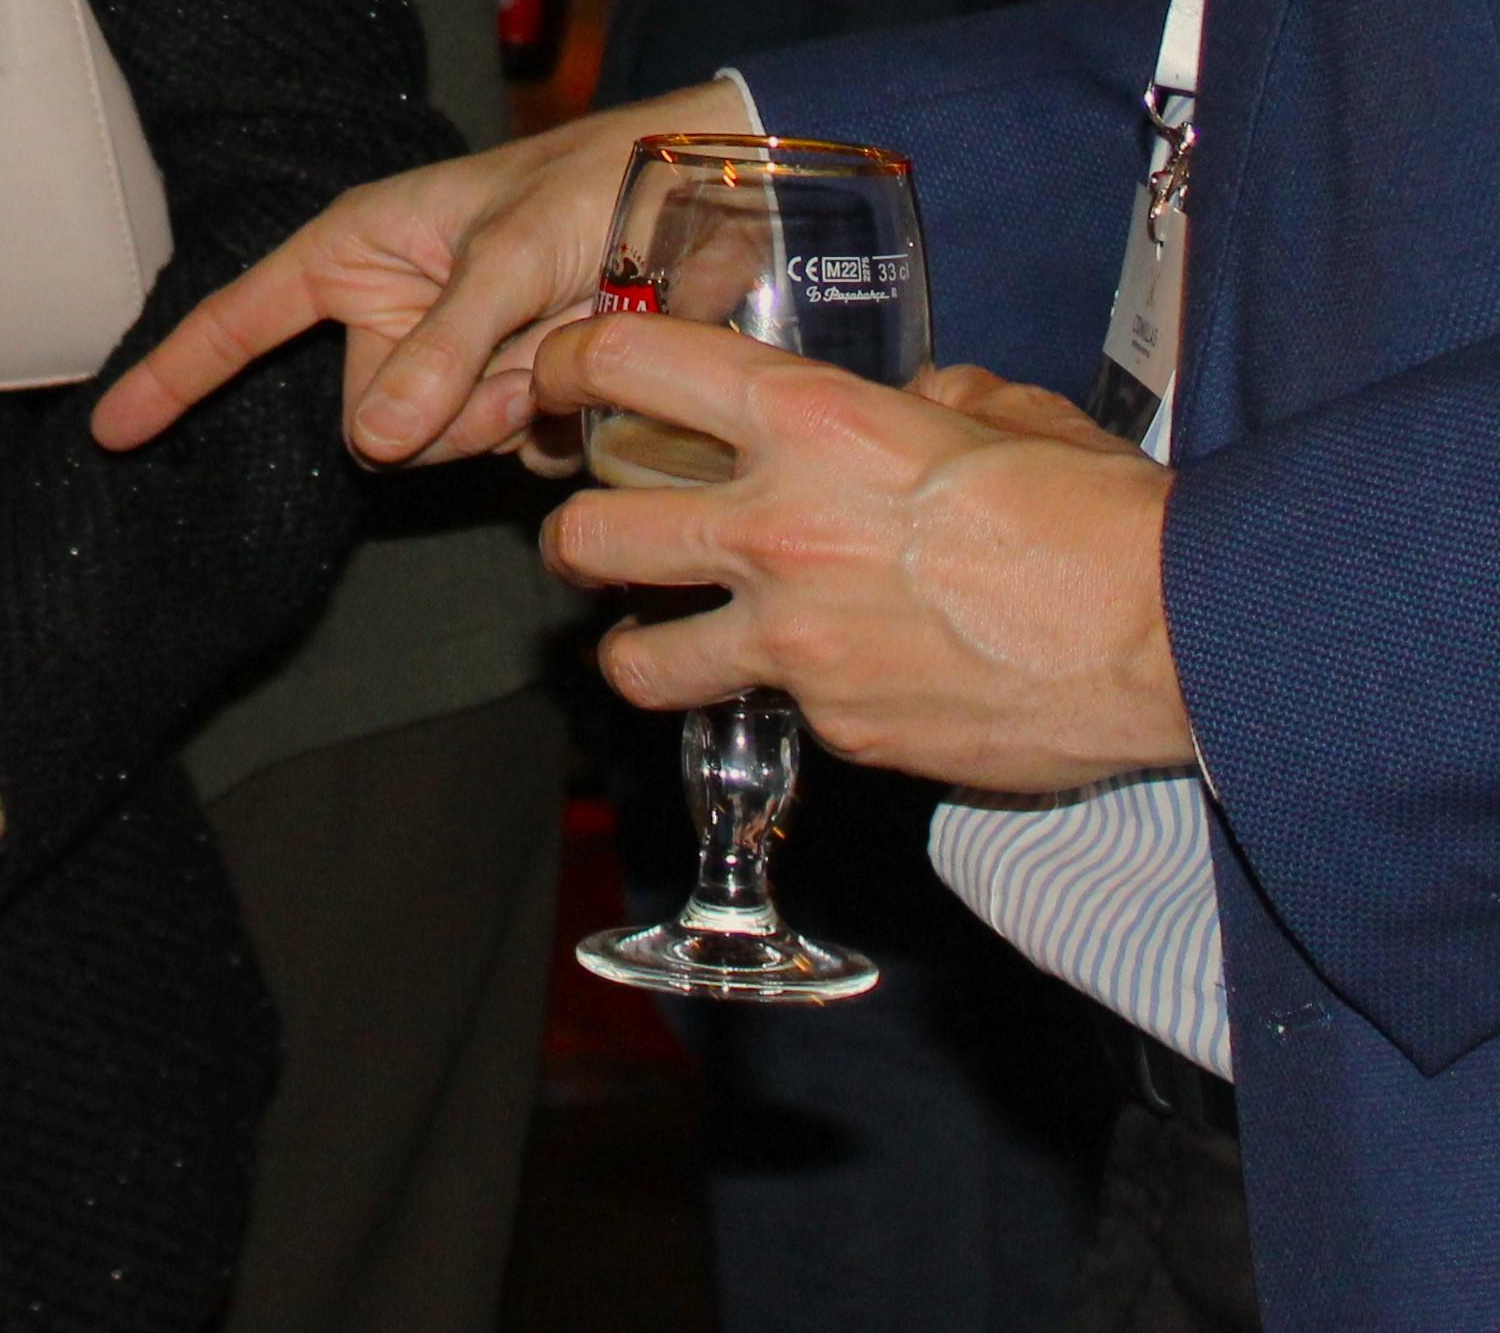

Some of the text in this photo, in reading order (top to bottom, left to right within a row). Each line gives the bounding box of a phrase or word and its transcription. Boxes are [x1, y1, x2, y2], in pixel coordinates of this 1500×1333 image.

[787, 256, 857, 282] CE M22
[878, 263, 896, 282] 33
